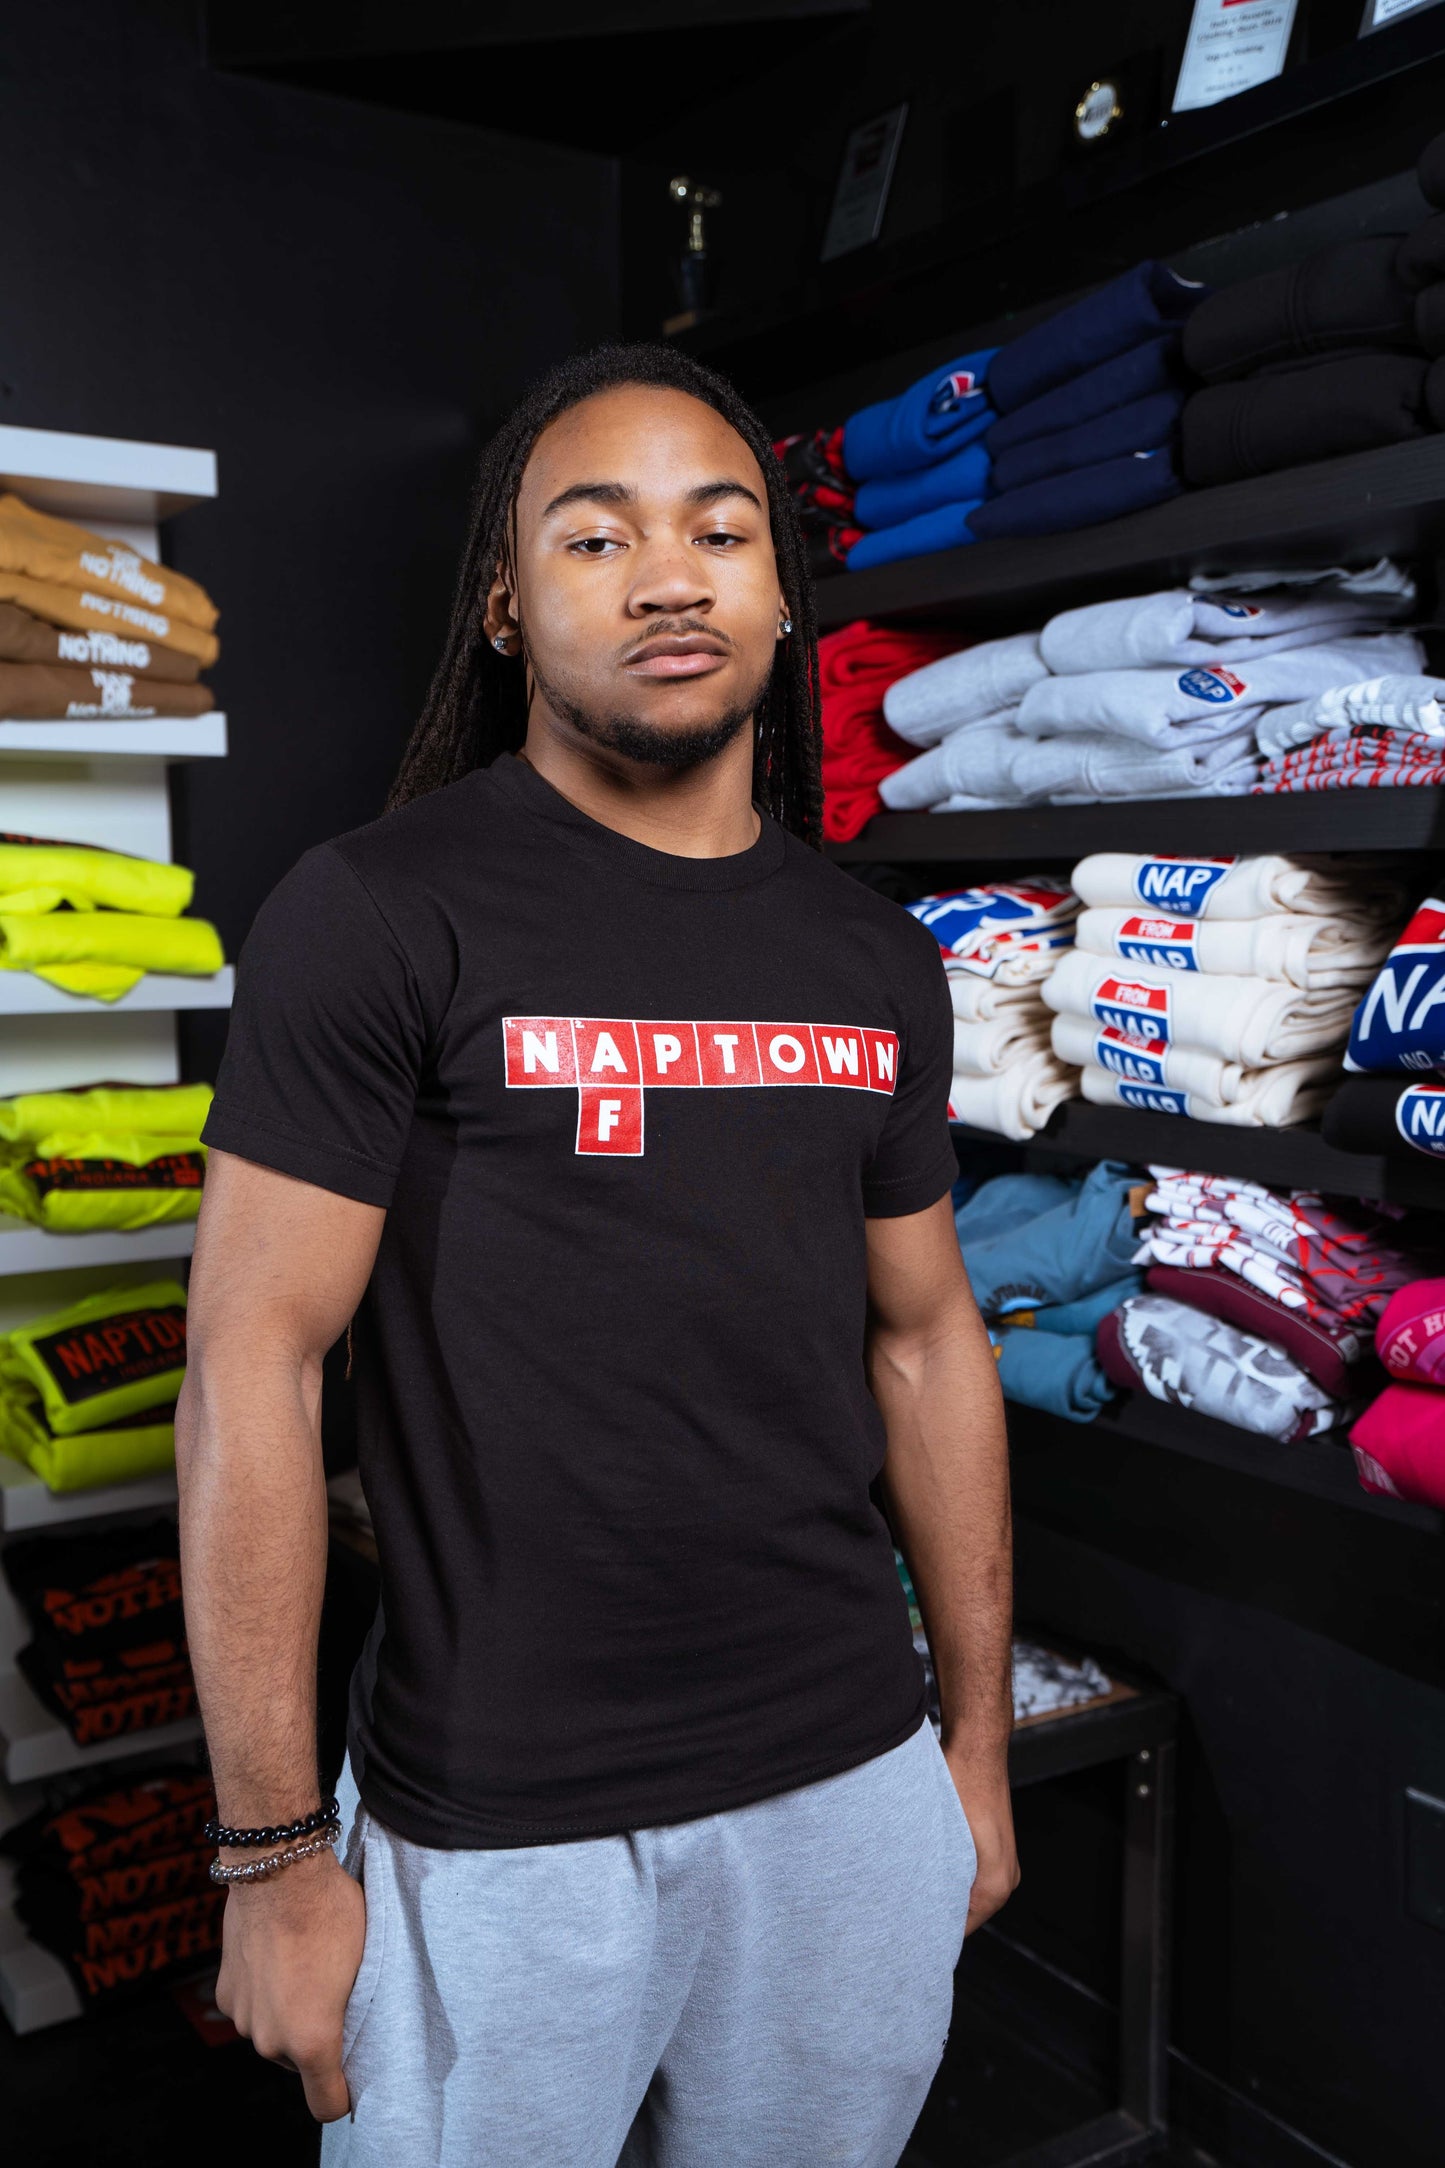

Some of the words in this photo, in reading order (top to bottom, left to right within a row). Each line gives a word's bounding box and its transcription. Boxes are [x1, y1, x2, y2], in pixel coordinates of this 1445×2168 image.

[1143, 866, 1212, 897] NAP
[1138, 920, 1177, 939] FROM
[1115, 985, 1151, 1008] FROM
[522, 1031, 894, 1082] NAPTOWN
[597, 1099, 622, 1142] F
